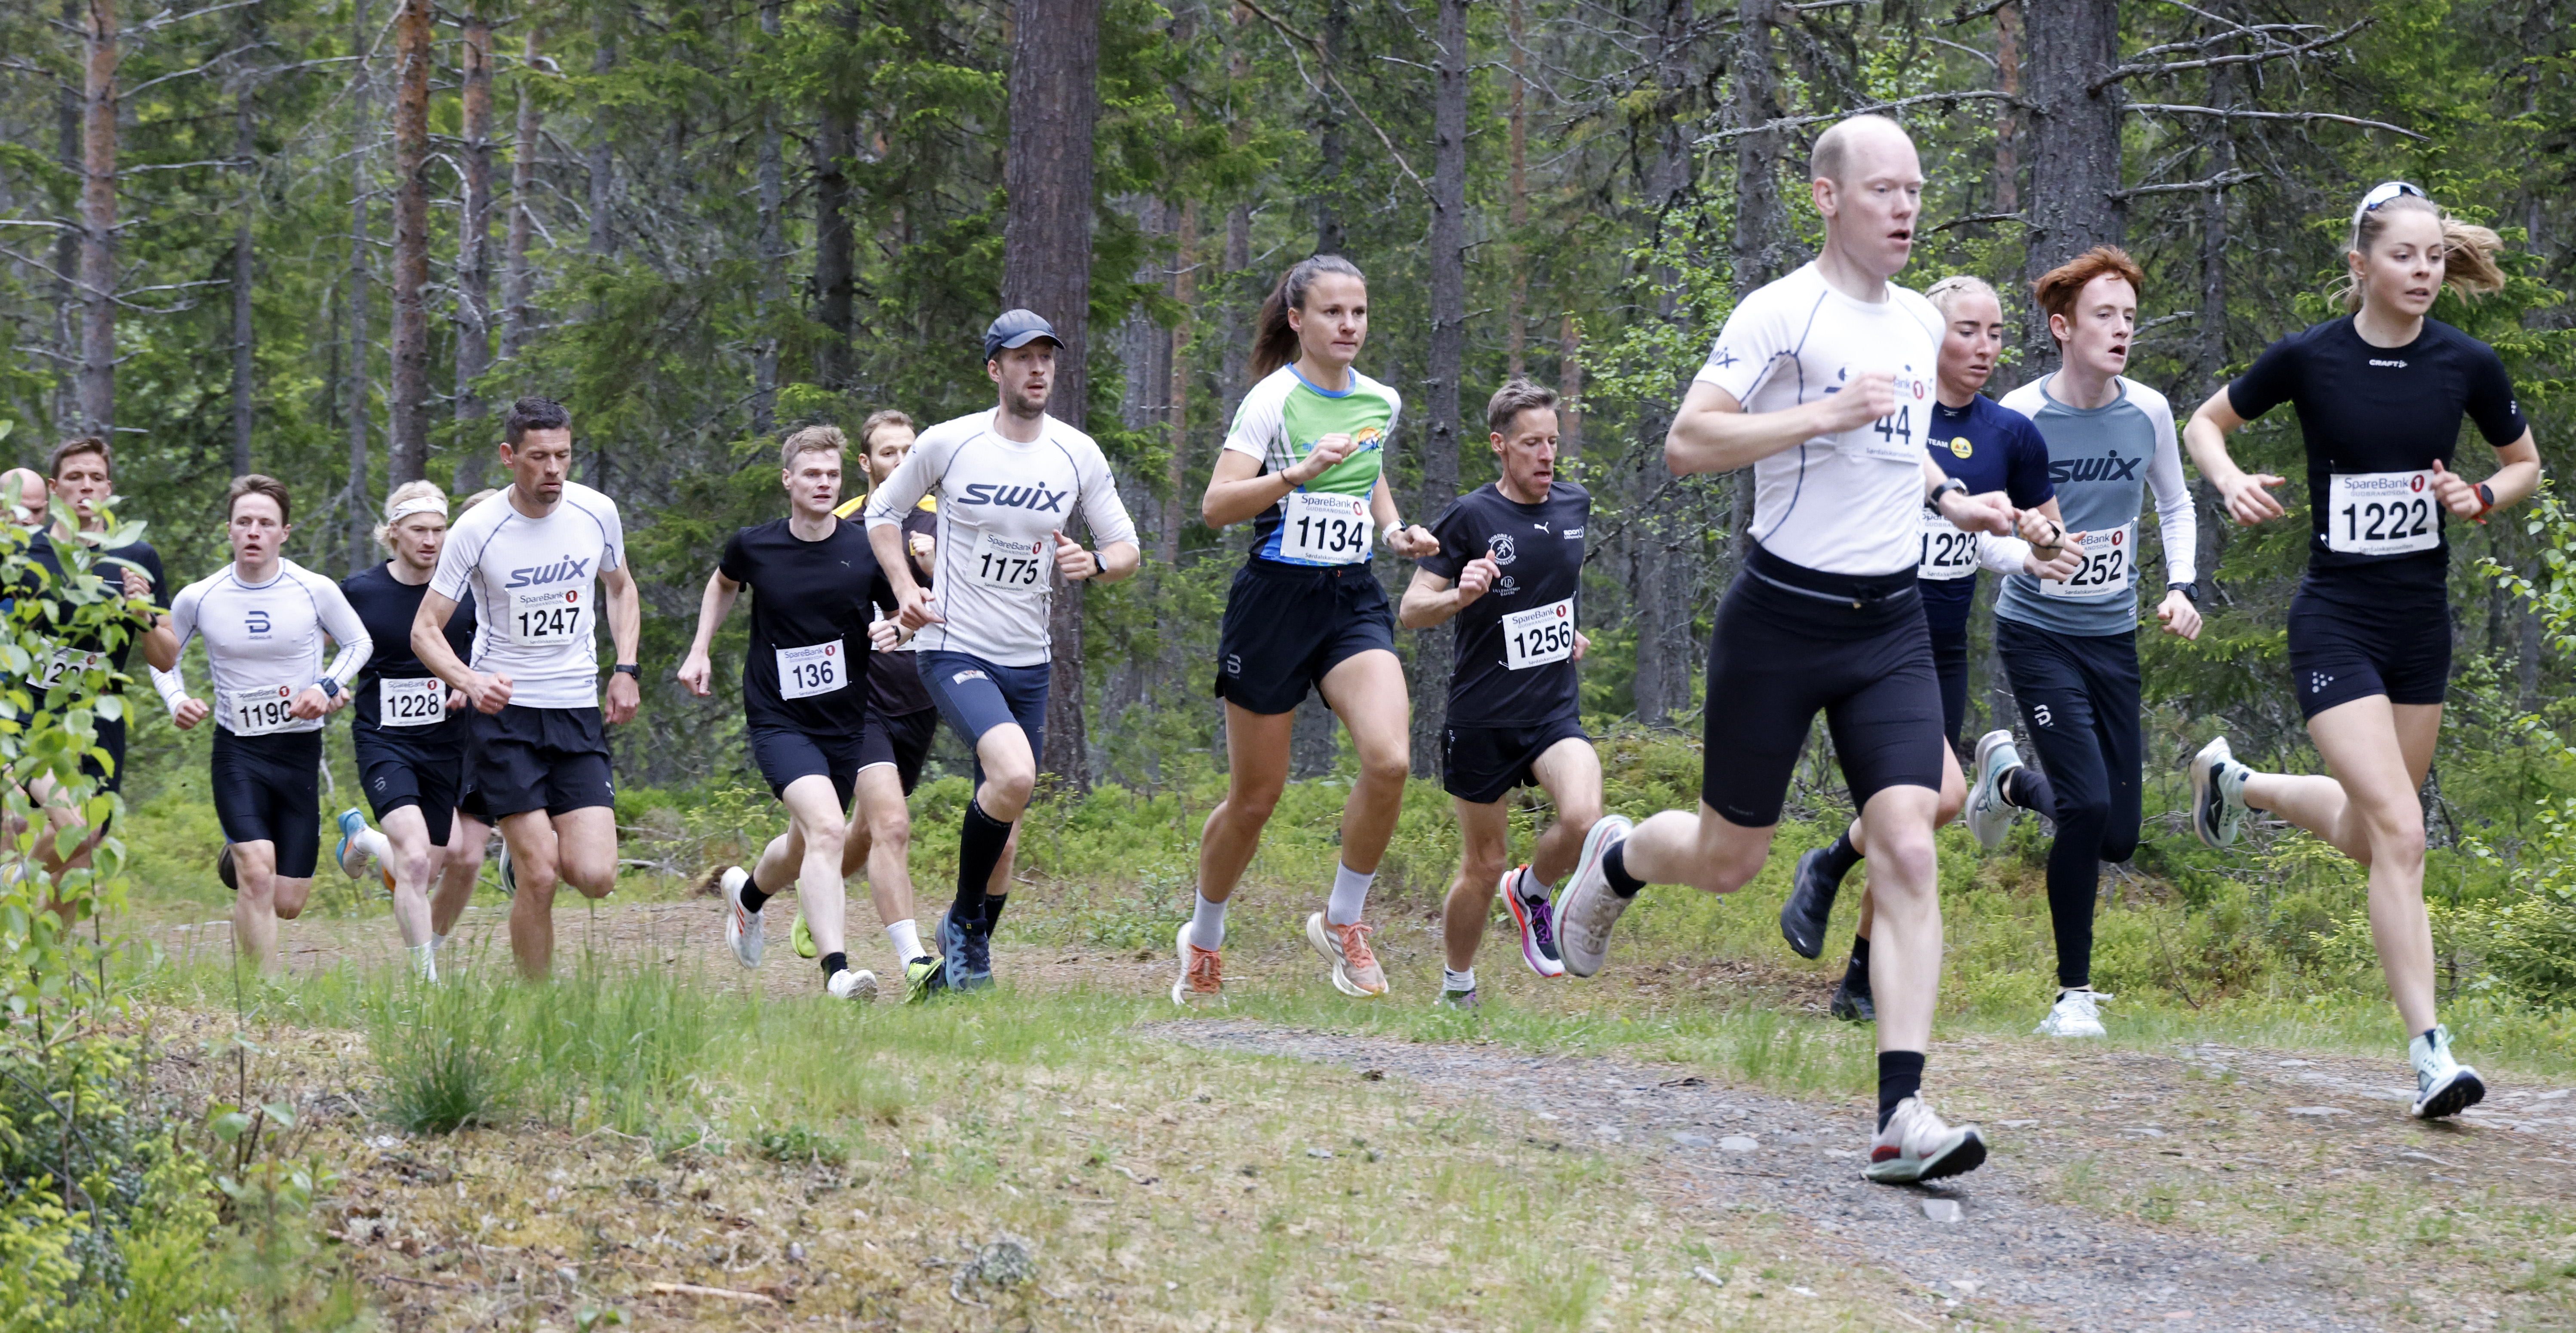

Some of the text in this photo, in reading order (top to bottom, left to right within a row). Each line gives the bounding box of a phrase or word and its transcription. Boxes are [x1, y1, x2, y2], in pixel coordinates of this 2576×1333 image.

[2369, 359, 2399, 367] CRAFT
[1928, 438, 1948, 448] TEAM
[2345, 477, 2409, 490] SpareBank
[1302, 494, 1351, 508] SpareBank
[1306, 506, 1351, 515] GUDBRANDSDAL
[2342, 498, 2427, 541] 1222
[987, 534, 1031, 551] SpareBank
[1297, 516, 1363, 553] 1134
[1305, 553, 1349, 562] Sørdalskarusellen
[1920, 532, 1977, 566] 1223
[981, 553, 1039, 584] 1175
[2058, 550, 2122, 586] 252
[520, 592, 564, 604] SpareBank
[518, 607, 579, 637] 1247
[1513, 608, 1554, 624] SpareBank
[1518, 616, 1556, 629] GUDBRANDSDAL
[1514, 621, 1570, 658] 1256
[785, 648, 823, 658] SpareBank
[793, 660, 833, 688] 136
[388, 693, 439, 717] 1228
[240, 700, 292, 728] 1190
